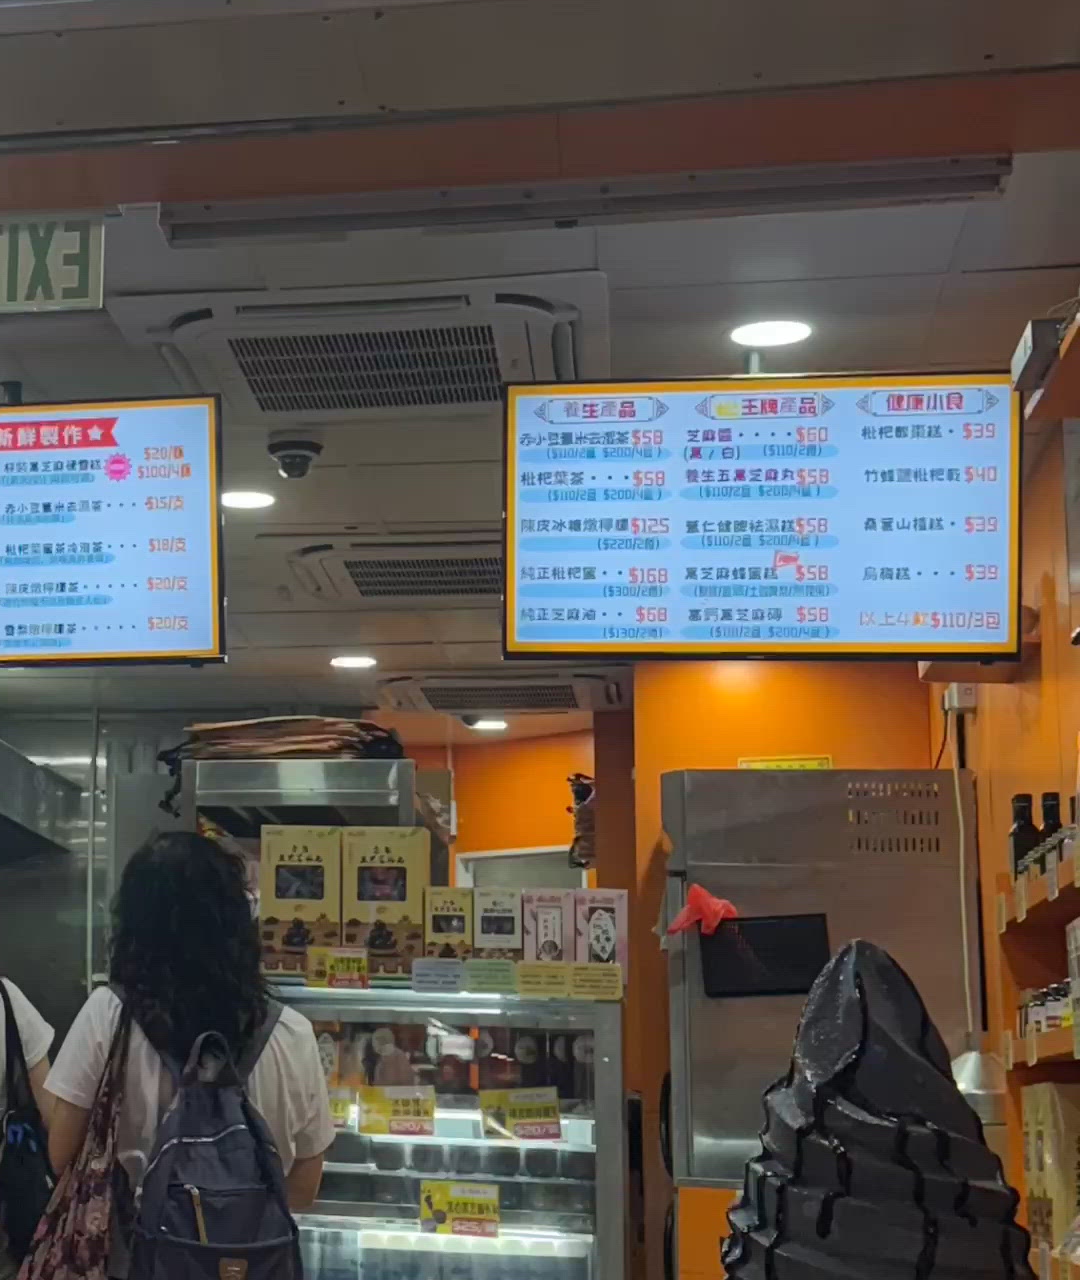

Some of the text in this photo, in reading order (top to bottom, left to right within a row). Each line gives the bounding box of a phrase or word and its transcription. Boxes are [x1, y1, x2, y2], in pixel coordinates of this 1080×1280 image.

[741, 397, 816, 415] 王牌產品
[632, 429, 664, 446] $58
[795, 426, 829, 444] $60
[962, 422, 995, 440] $39
[633, 470, 666, 487] $58
[964, 466, 997, 484] $40
[631, 517, 670, 535] $125
[795, 517, 828, 535] $58
[964, 516, 998, 534] $39
[628, 567, 669, 584] $168
[796, 565, 829, 582] $58
[965, 564, 998, 582] $39
[635, 606, 668, 624] $68
[796, 606, 829, 624] $58
